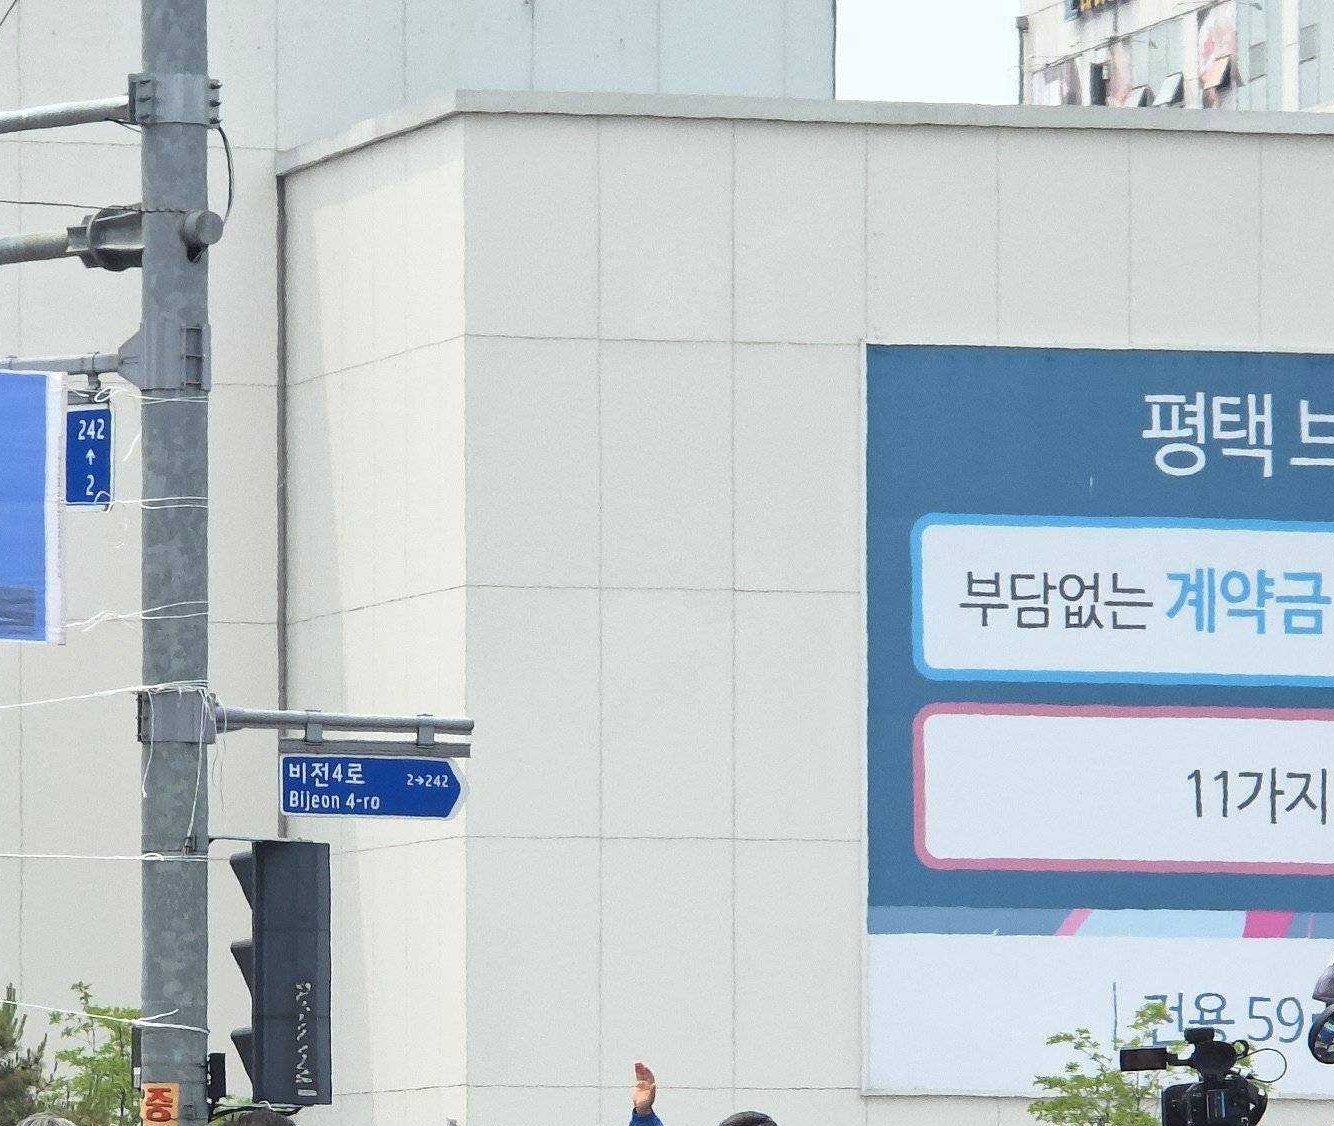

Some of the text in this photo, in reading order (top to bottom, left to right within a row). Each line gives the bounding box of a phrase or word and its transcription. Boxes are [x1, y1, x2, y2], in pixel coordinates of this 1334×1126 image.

[77, 418, 105, 440] 242
[1142, 391, 1274, 478] 평택
[86, 474, 95, 496] 2
[958, 571, 1154, 631] 부담없는
[1164, 567, 1330, 637] 계약금
[288, 761, 366, 788] 비전4로
[289, 790, 380, 811] Bijeon 4-ro
[1187, 767, 1329, 827] 11가지
[1247, 996, 1322, 1044] 59
